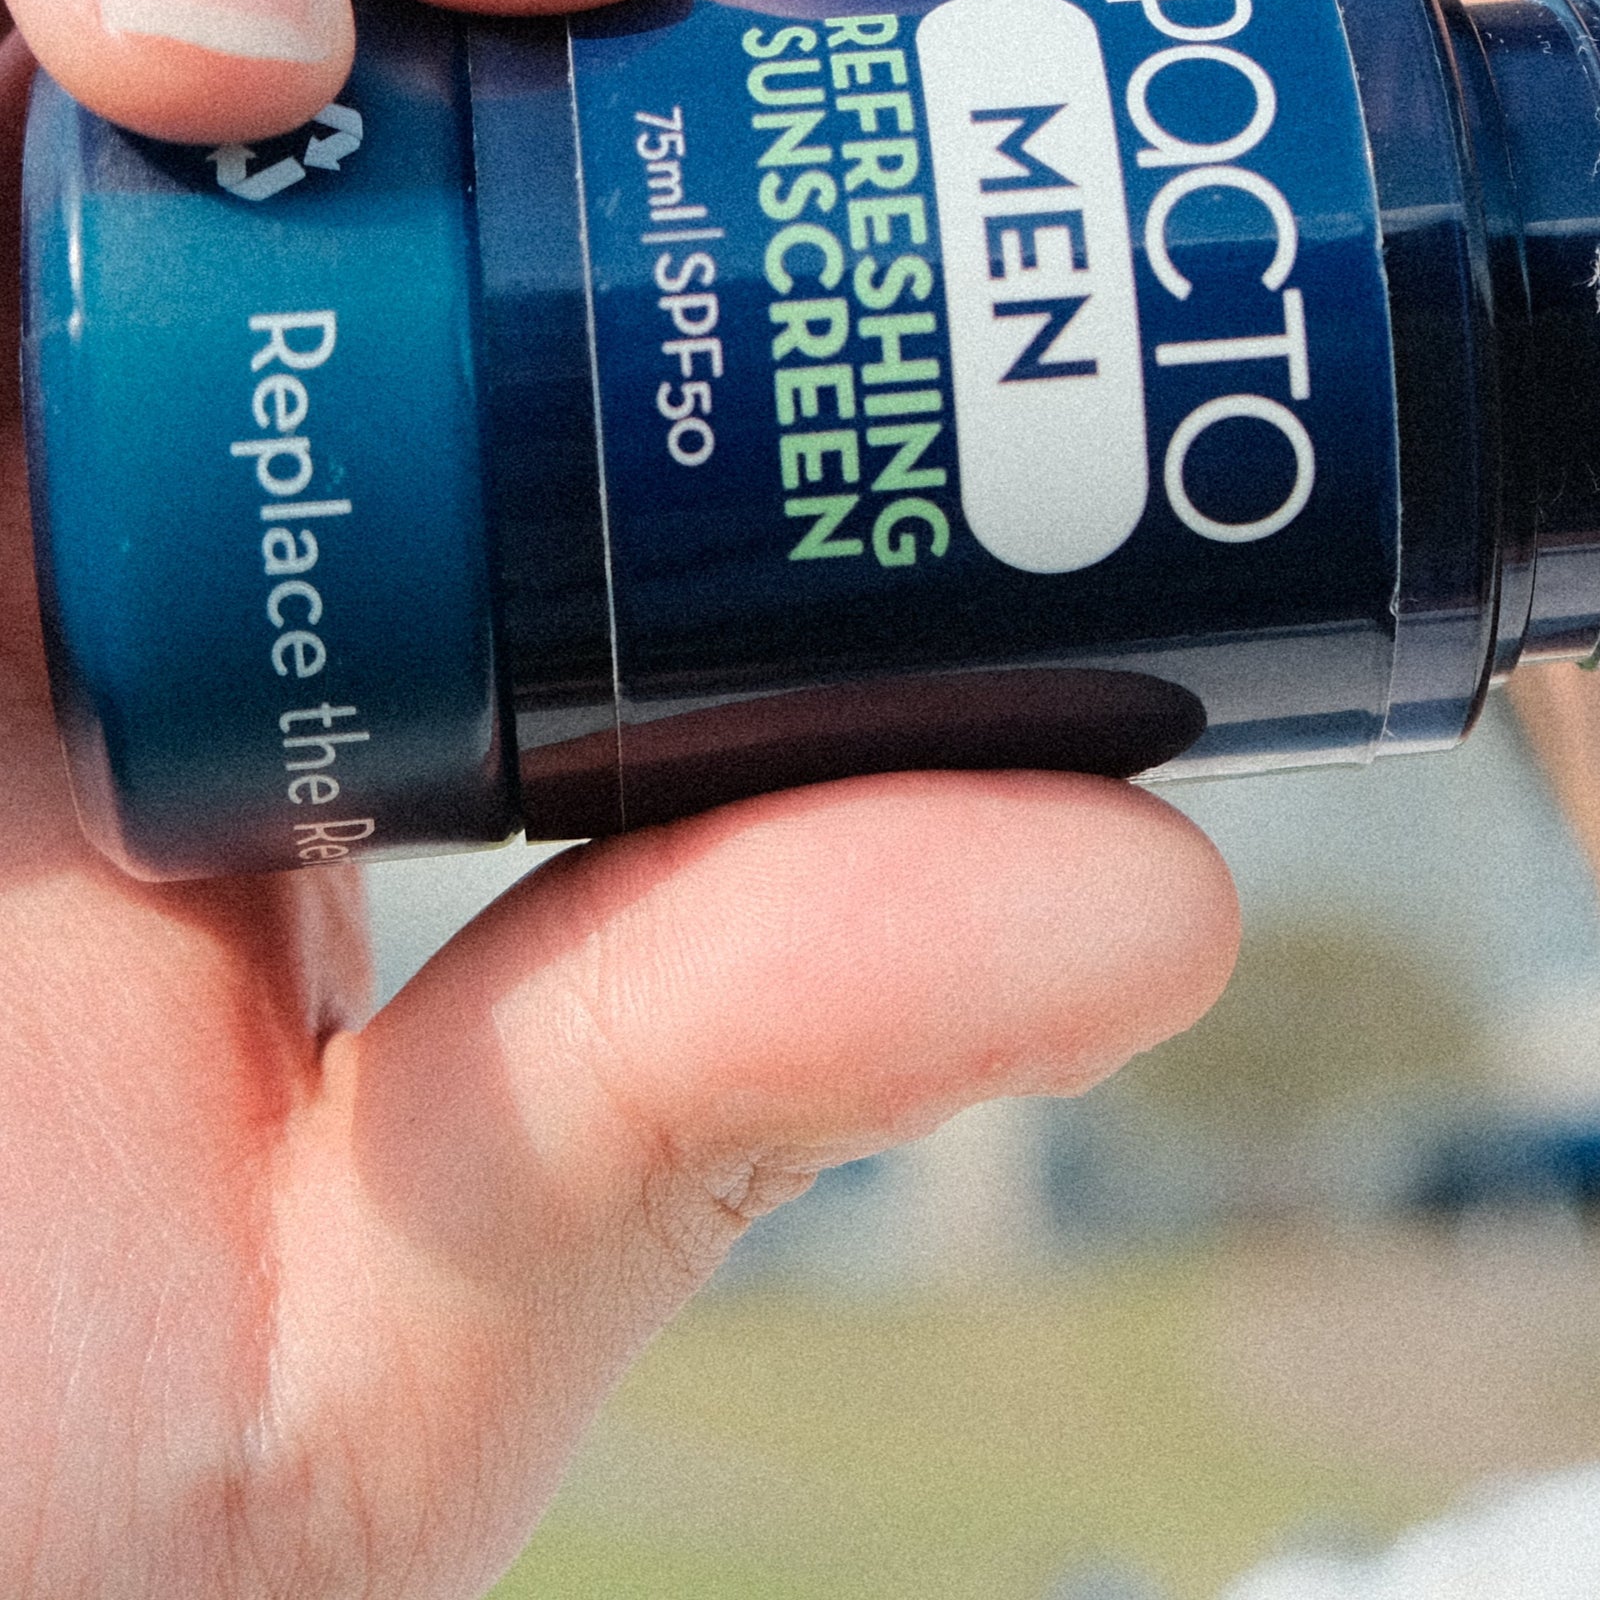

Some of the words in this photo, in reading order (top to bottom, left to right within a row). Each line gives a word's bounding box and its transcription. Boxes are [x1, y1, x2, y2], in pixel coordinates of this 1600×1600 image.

[741, 26, 864, 561] SUNSCREEN
[823, 13, 951, 568] REFRESHING
[969, 102, 1100, 385] MEN
[230, 309, 353, 678] Replace
[277, 702, 371, 805] the
